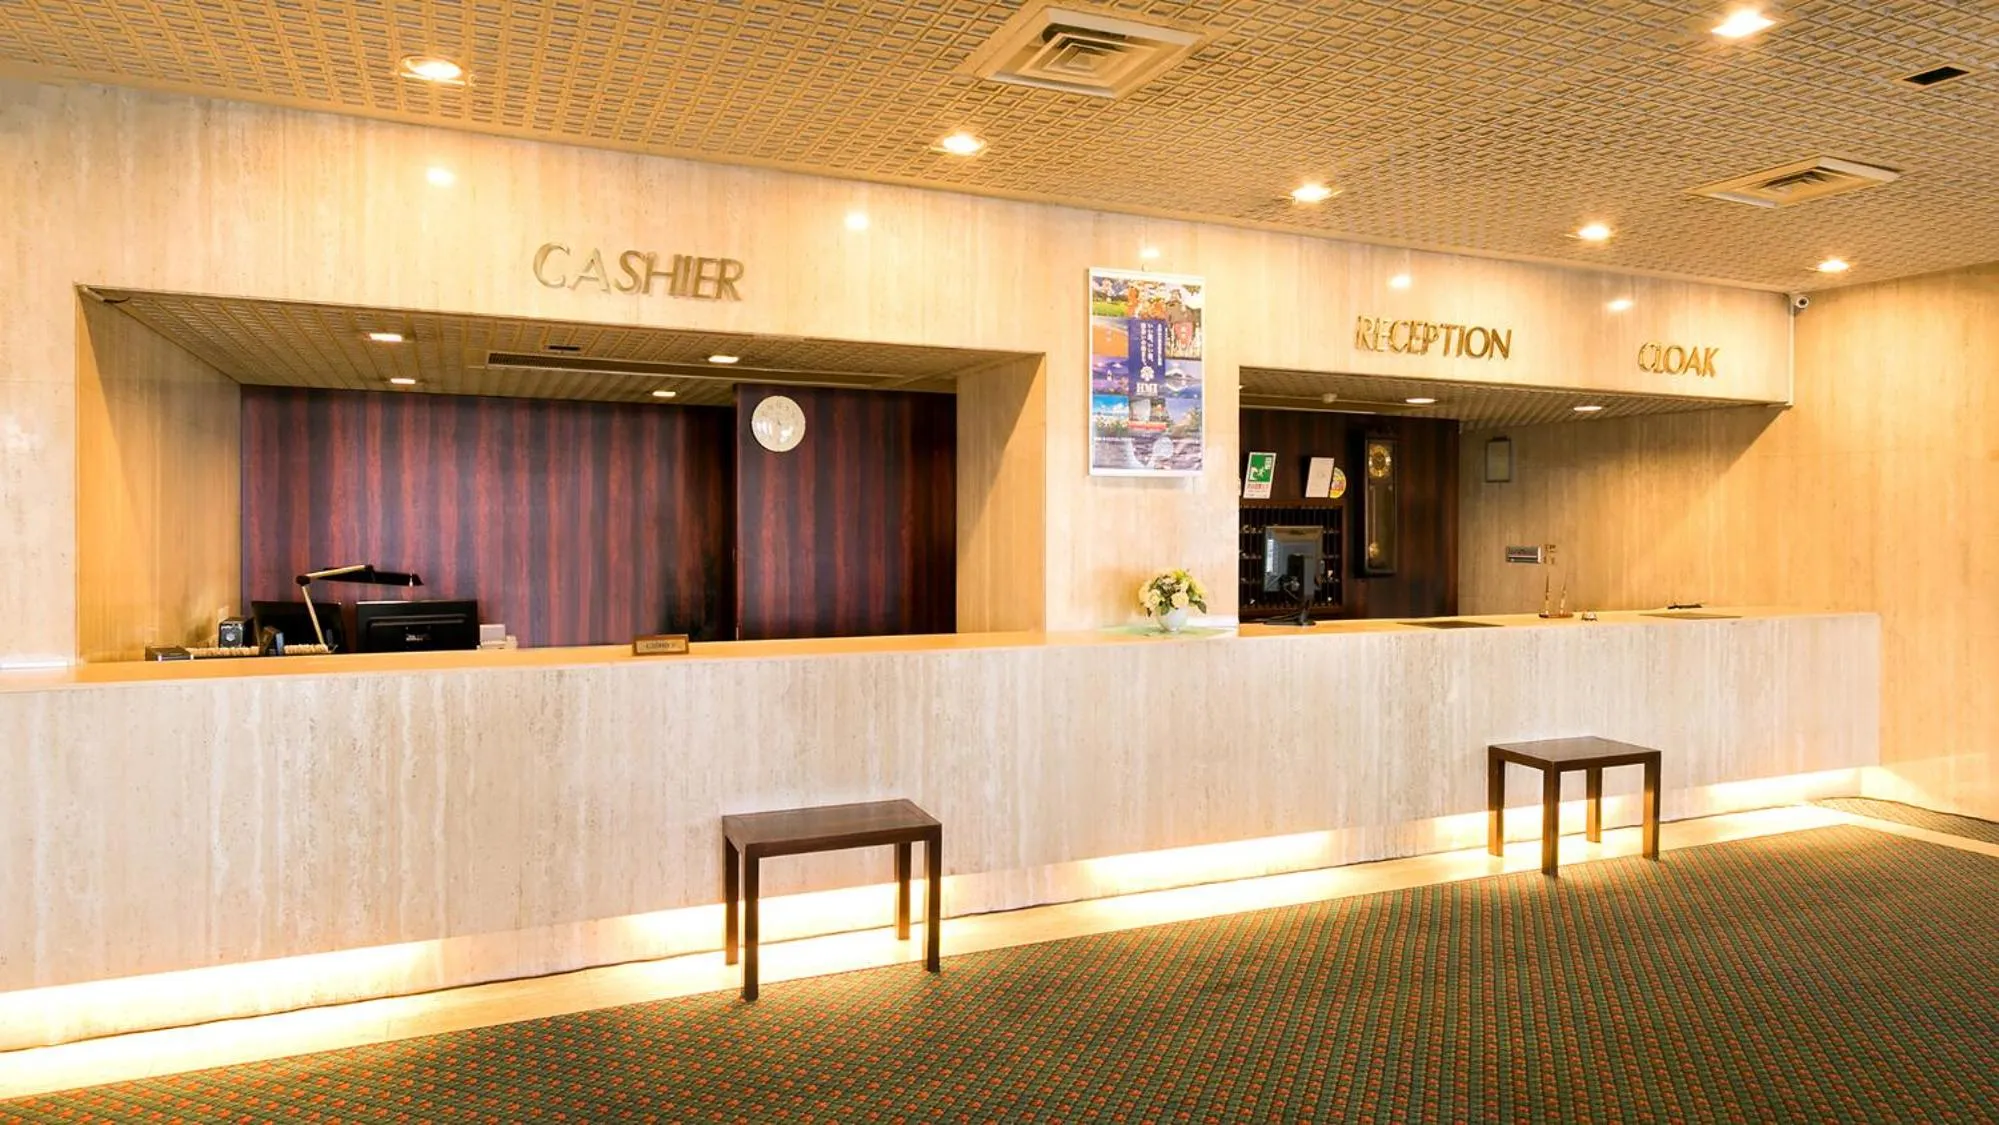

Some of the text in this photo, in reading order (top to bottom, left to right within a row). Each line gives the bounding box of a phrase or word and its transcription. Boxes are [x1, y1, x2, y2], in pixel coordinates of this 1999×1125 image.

[532, 242, 745, 302] CASHIER
[1355, 315, 1513, 361] RECEPTION
[1637, 341, 1720, 378] CLOAK
